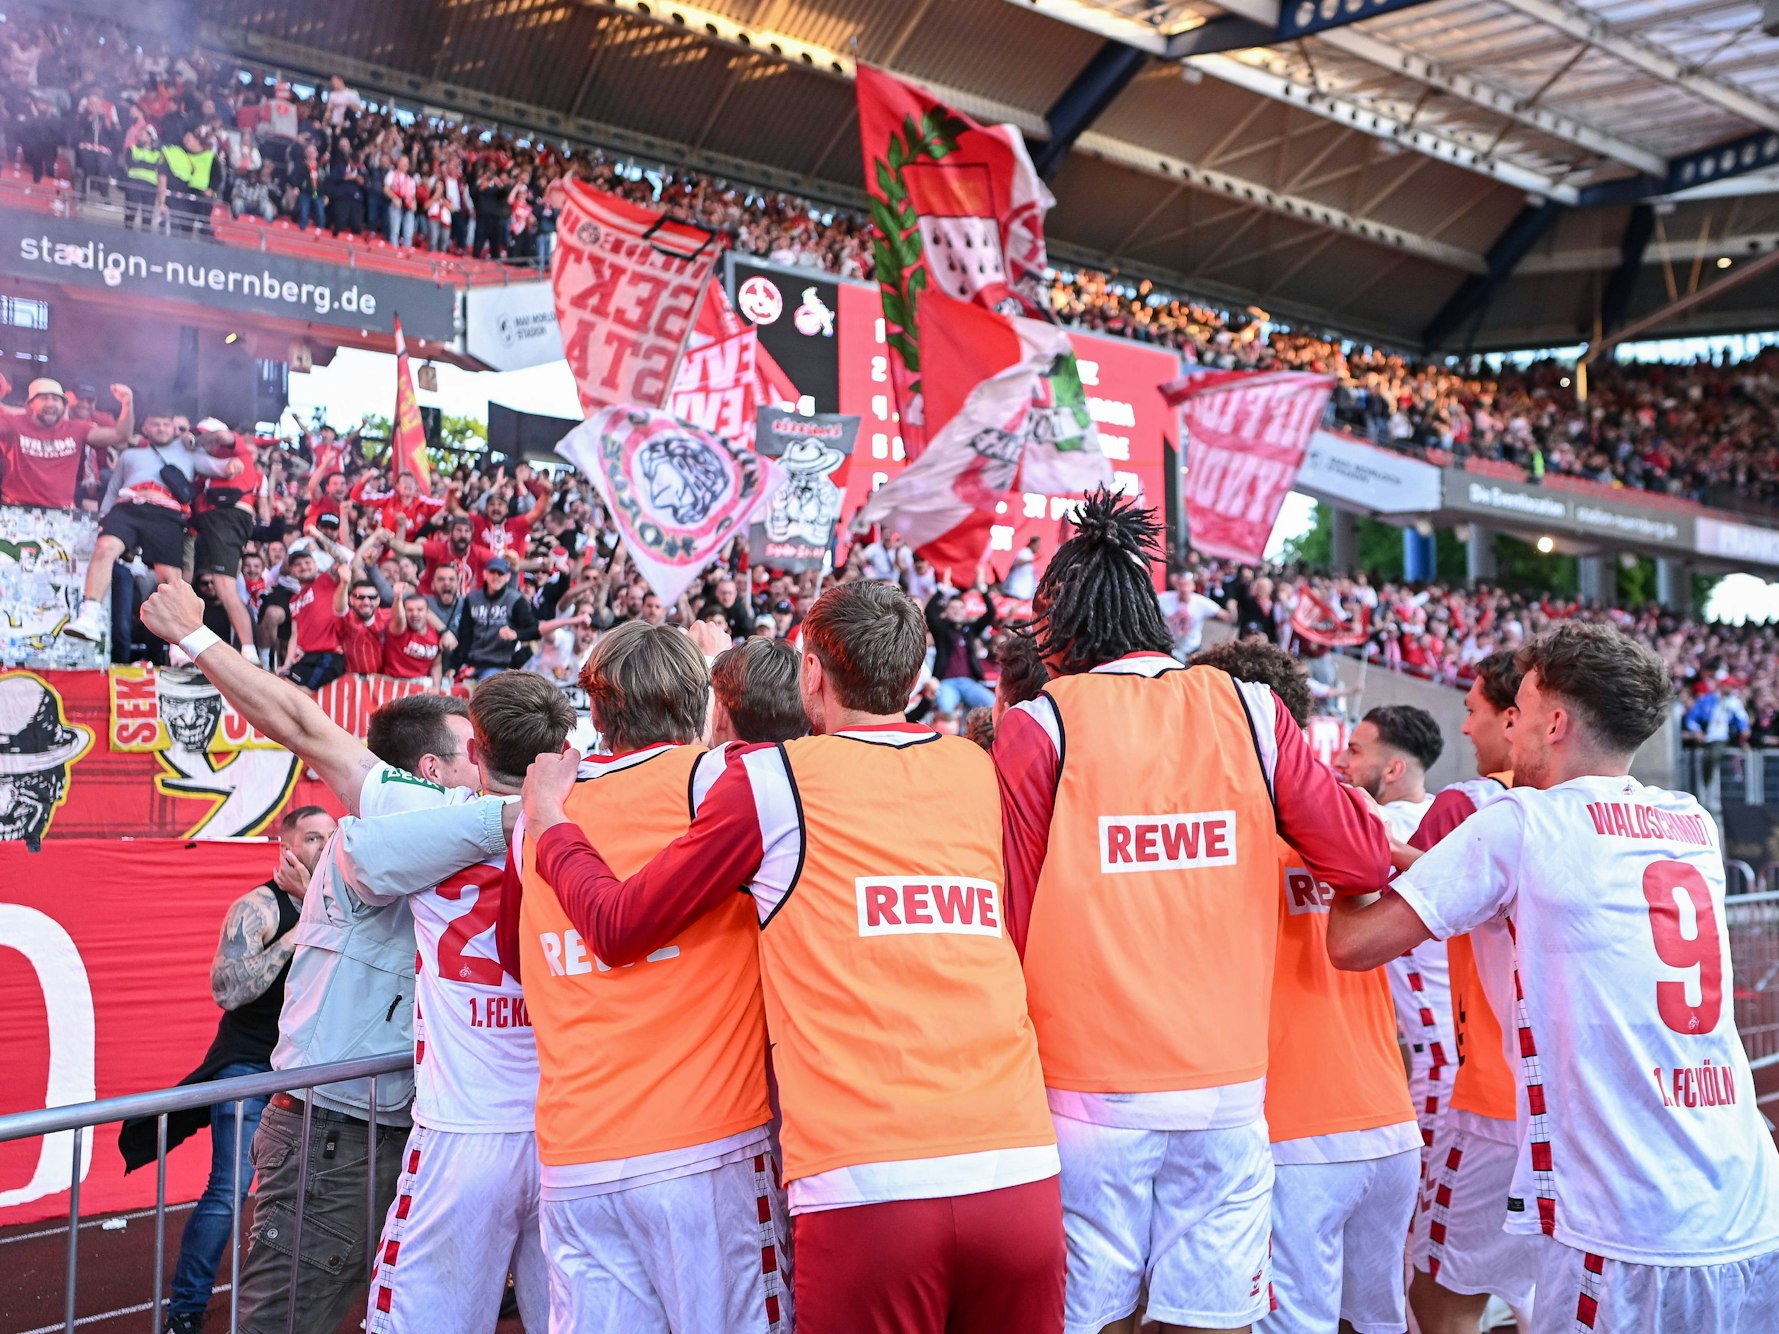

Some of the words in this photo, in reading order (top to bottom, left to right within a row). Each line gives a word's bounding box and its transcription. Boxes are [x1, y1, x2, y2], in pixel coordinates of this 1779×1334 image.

[20, 234, 377, 316] stadion-nuernberg.de
[1107, 819, 1230, 864] REWE
[1586, 801, 1713, 847] WALDSCHMIDT
[865, 885, 998, 928] REWE
[1289, 875, 1333, 907] RE
[539, 929, 680, 977] RE
[1642, 860, 1723, 1035] 9
[1694, 1058, 1737, 1107] KÖLN
